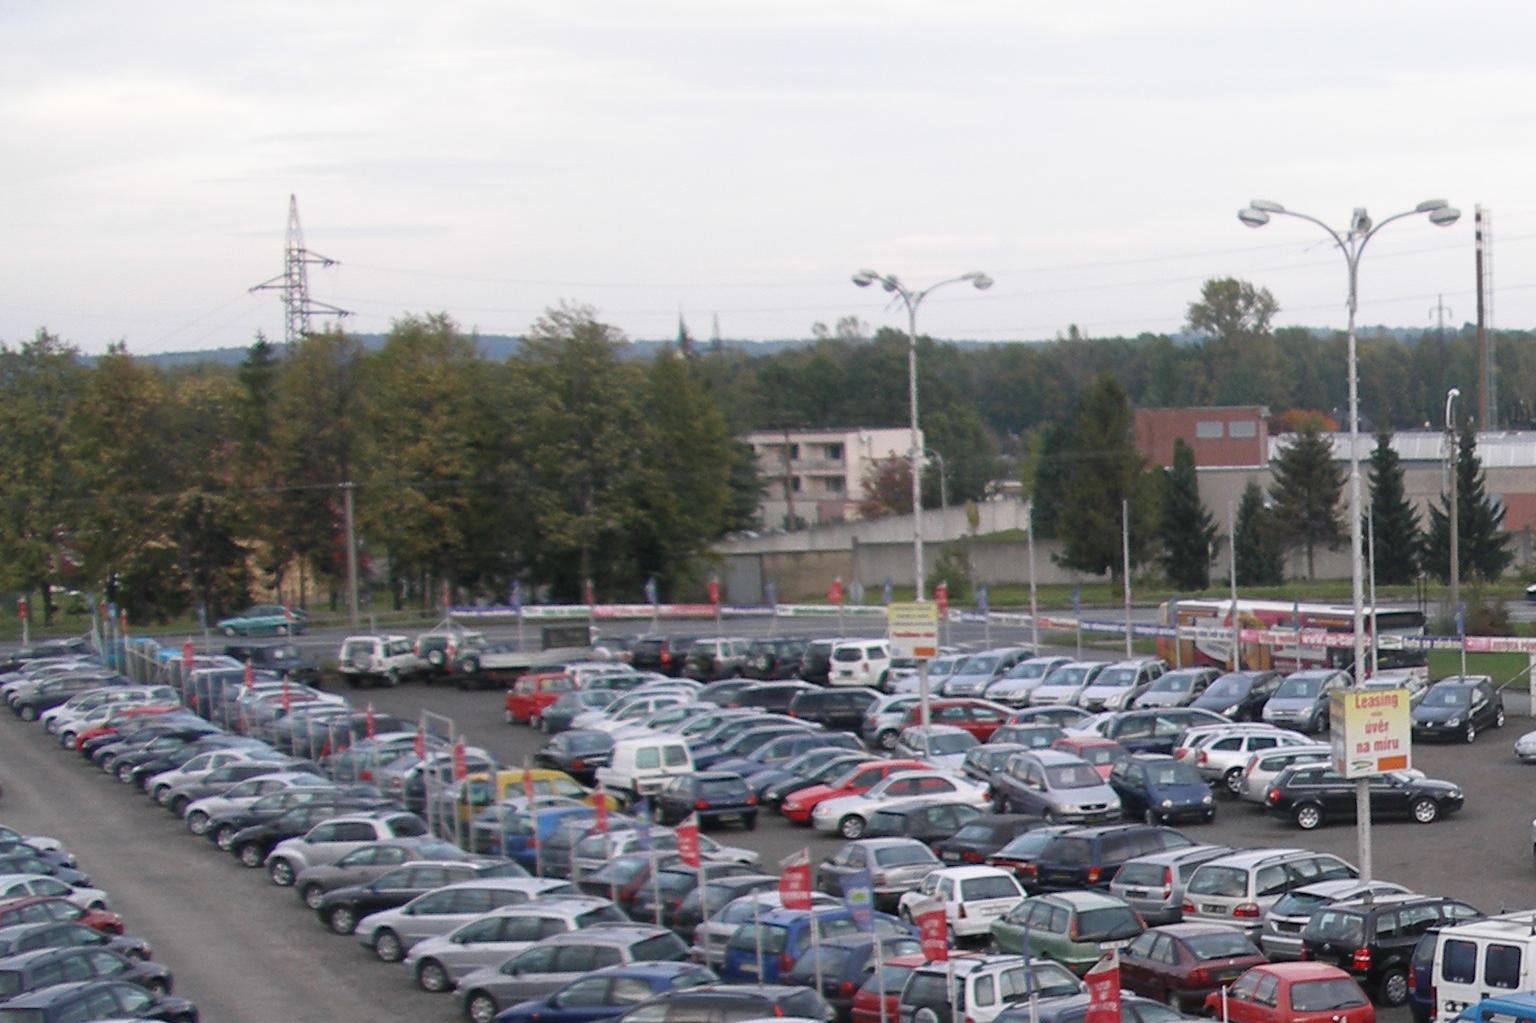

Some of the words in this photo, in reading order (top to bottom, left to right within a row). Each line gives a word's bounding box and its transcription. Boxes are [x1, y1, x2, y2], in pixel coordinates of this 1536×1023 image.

[1355, 692, 1399, 709] Leasing
[1364, 719, 1389, 735] úvěr
[1356, 741, 1370, 753] na
